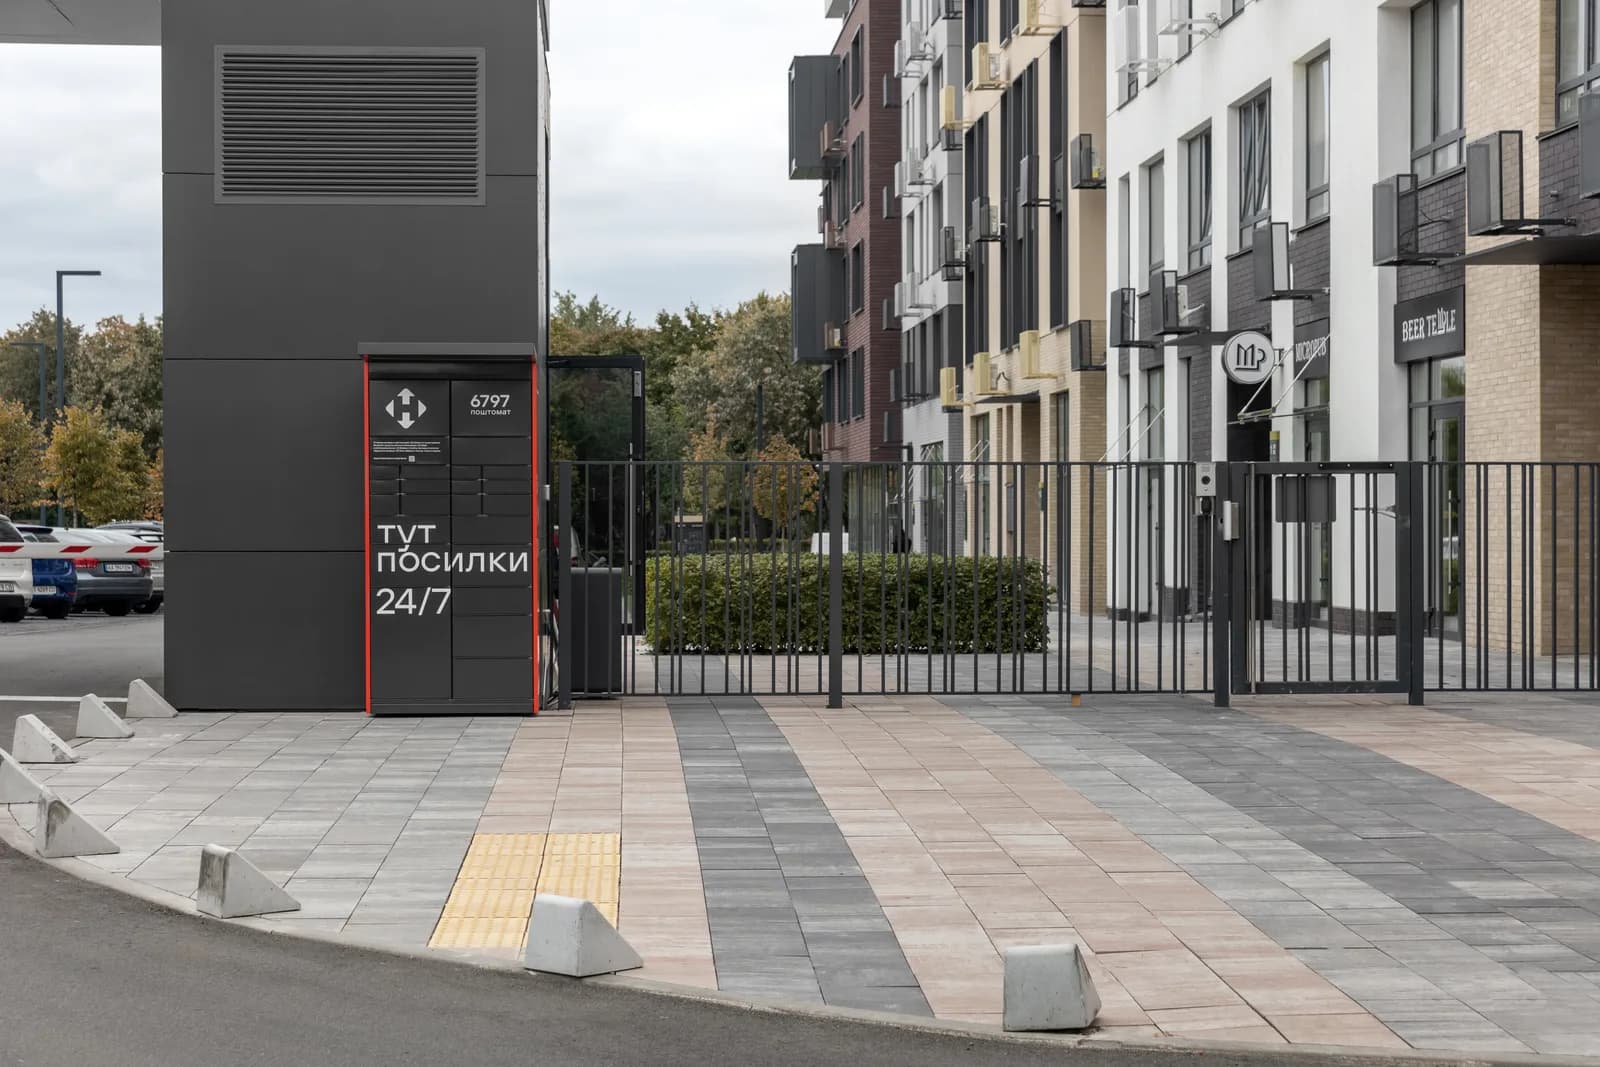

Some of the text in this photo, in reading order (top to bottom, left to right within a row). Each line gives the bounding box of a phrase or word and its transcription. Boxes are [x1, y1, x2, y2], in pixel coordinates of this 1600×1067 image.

[1402, 307, 1456, 342] BEER TEMPLE
[470, 394, 510, 408] 6797
[470, 408, 511, 416] поштомат
[377, 551, 528, 573] посилки
[376, 587, 451, 616] 24/7
